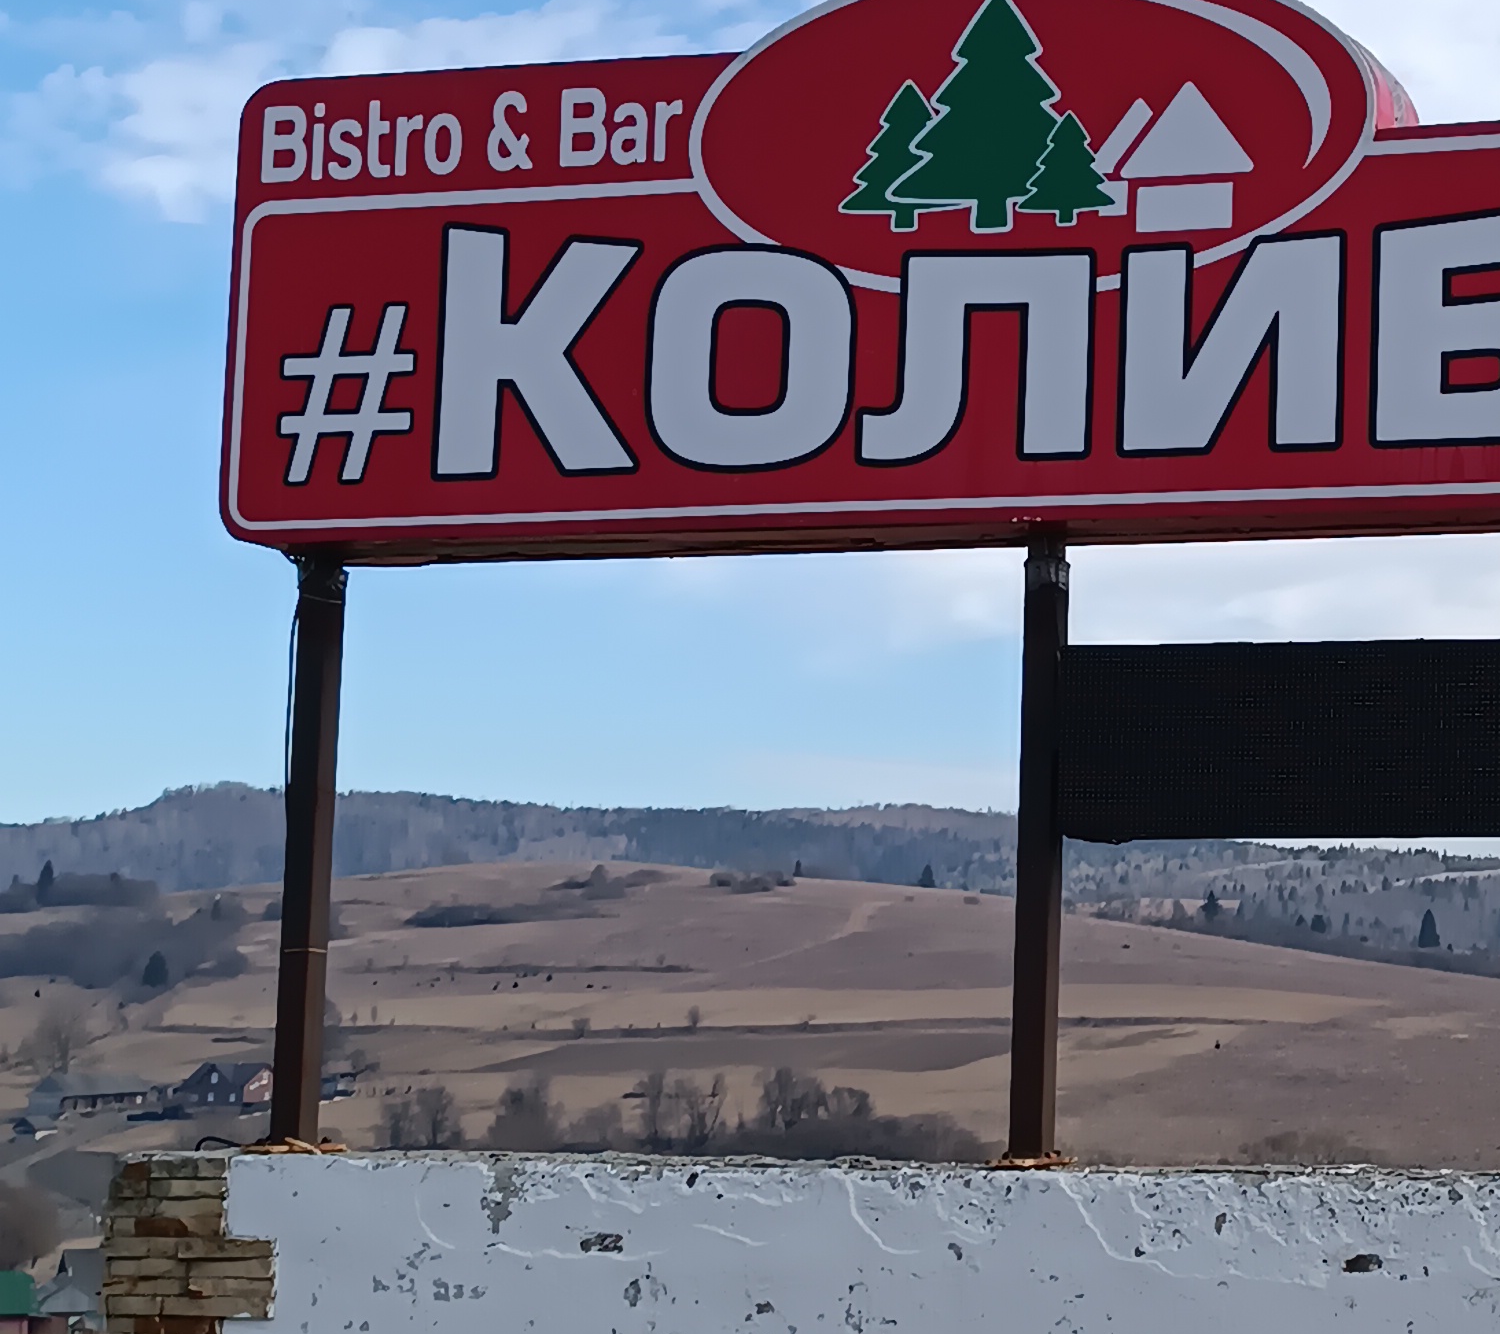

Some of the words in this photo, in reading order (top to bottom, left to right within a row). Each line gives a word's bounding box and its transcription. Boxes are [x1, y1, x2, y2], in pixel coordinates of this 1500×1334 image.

[259, 98, 463, 184] Bistro
[487, 91, 533, 172] &
[559, 87, 684, 168] Bar
